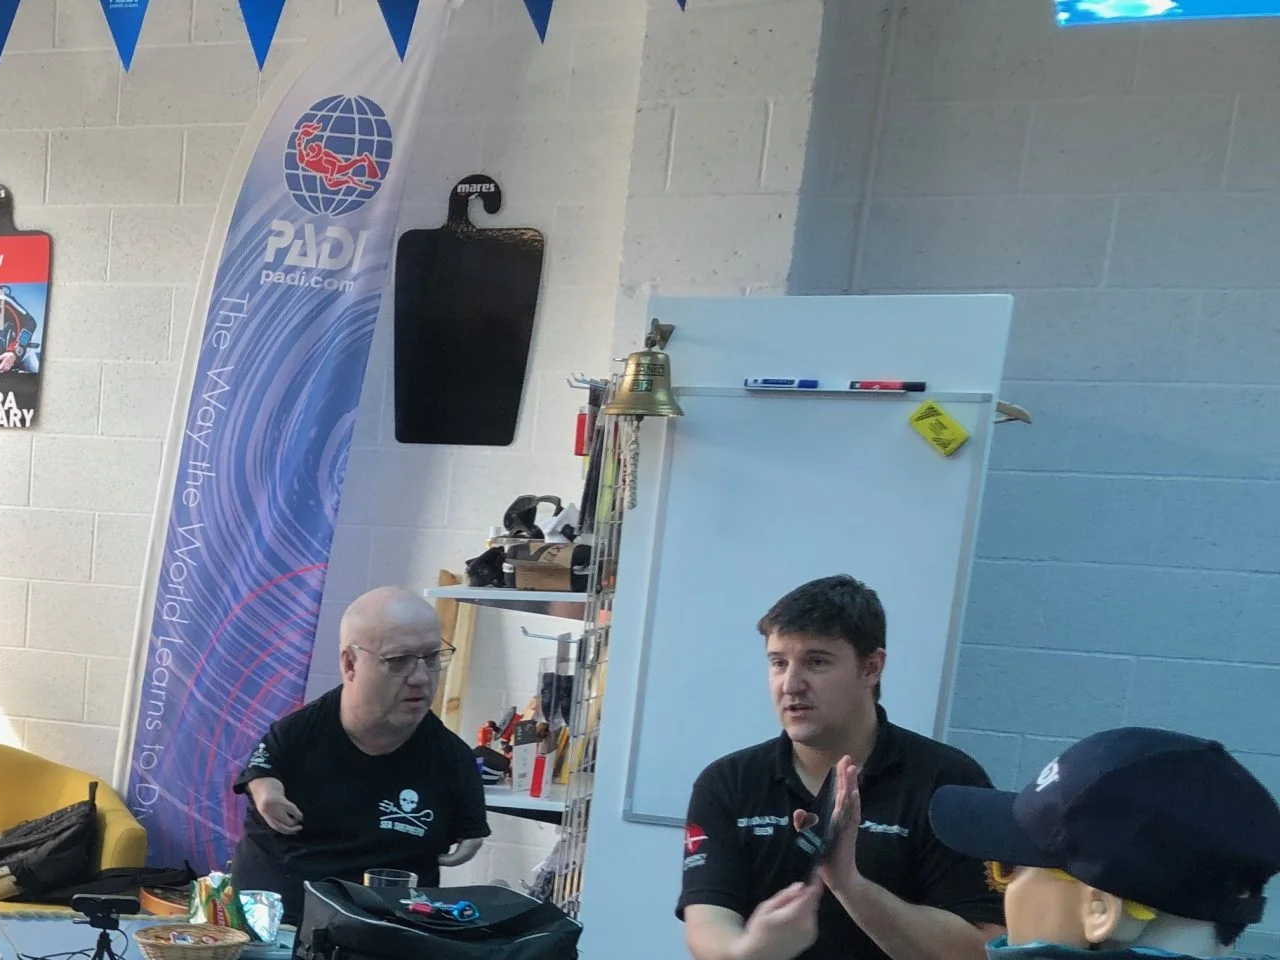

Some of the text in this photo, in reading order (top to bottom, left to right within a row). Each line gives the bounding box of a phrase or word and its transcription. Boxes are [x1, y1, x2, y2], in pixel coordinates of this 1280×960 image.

[456, 183, 496, 193] mares
[264, 219, 369, 274] PADI
[260, 269, 355, 292] padi.com
[212, 292, 250, 350] The
[185, 366, 235, 448] Way
[182, 460, 217, 508] the
[162, 522, 205, 625] World
[145, 634, 185, 731] Learns
[138, 743, 165, 770] to
